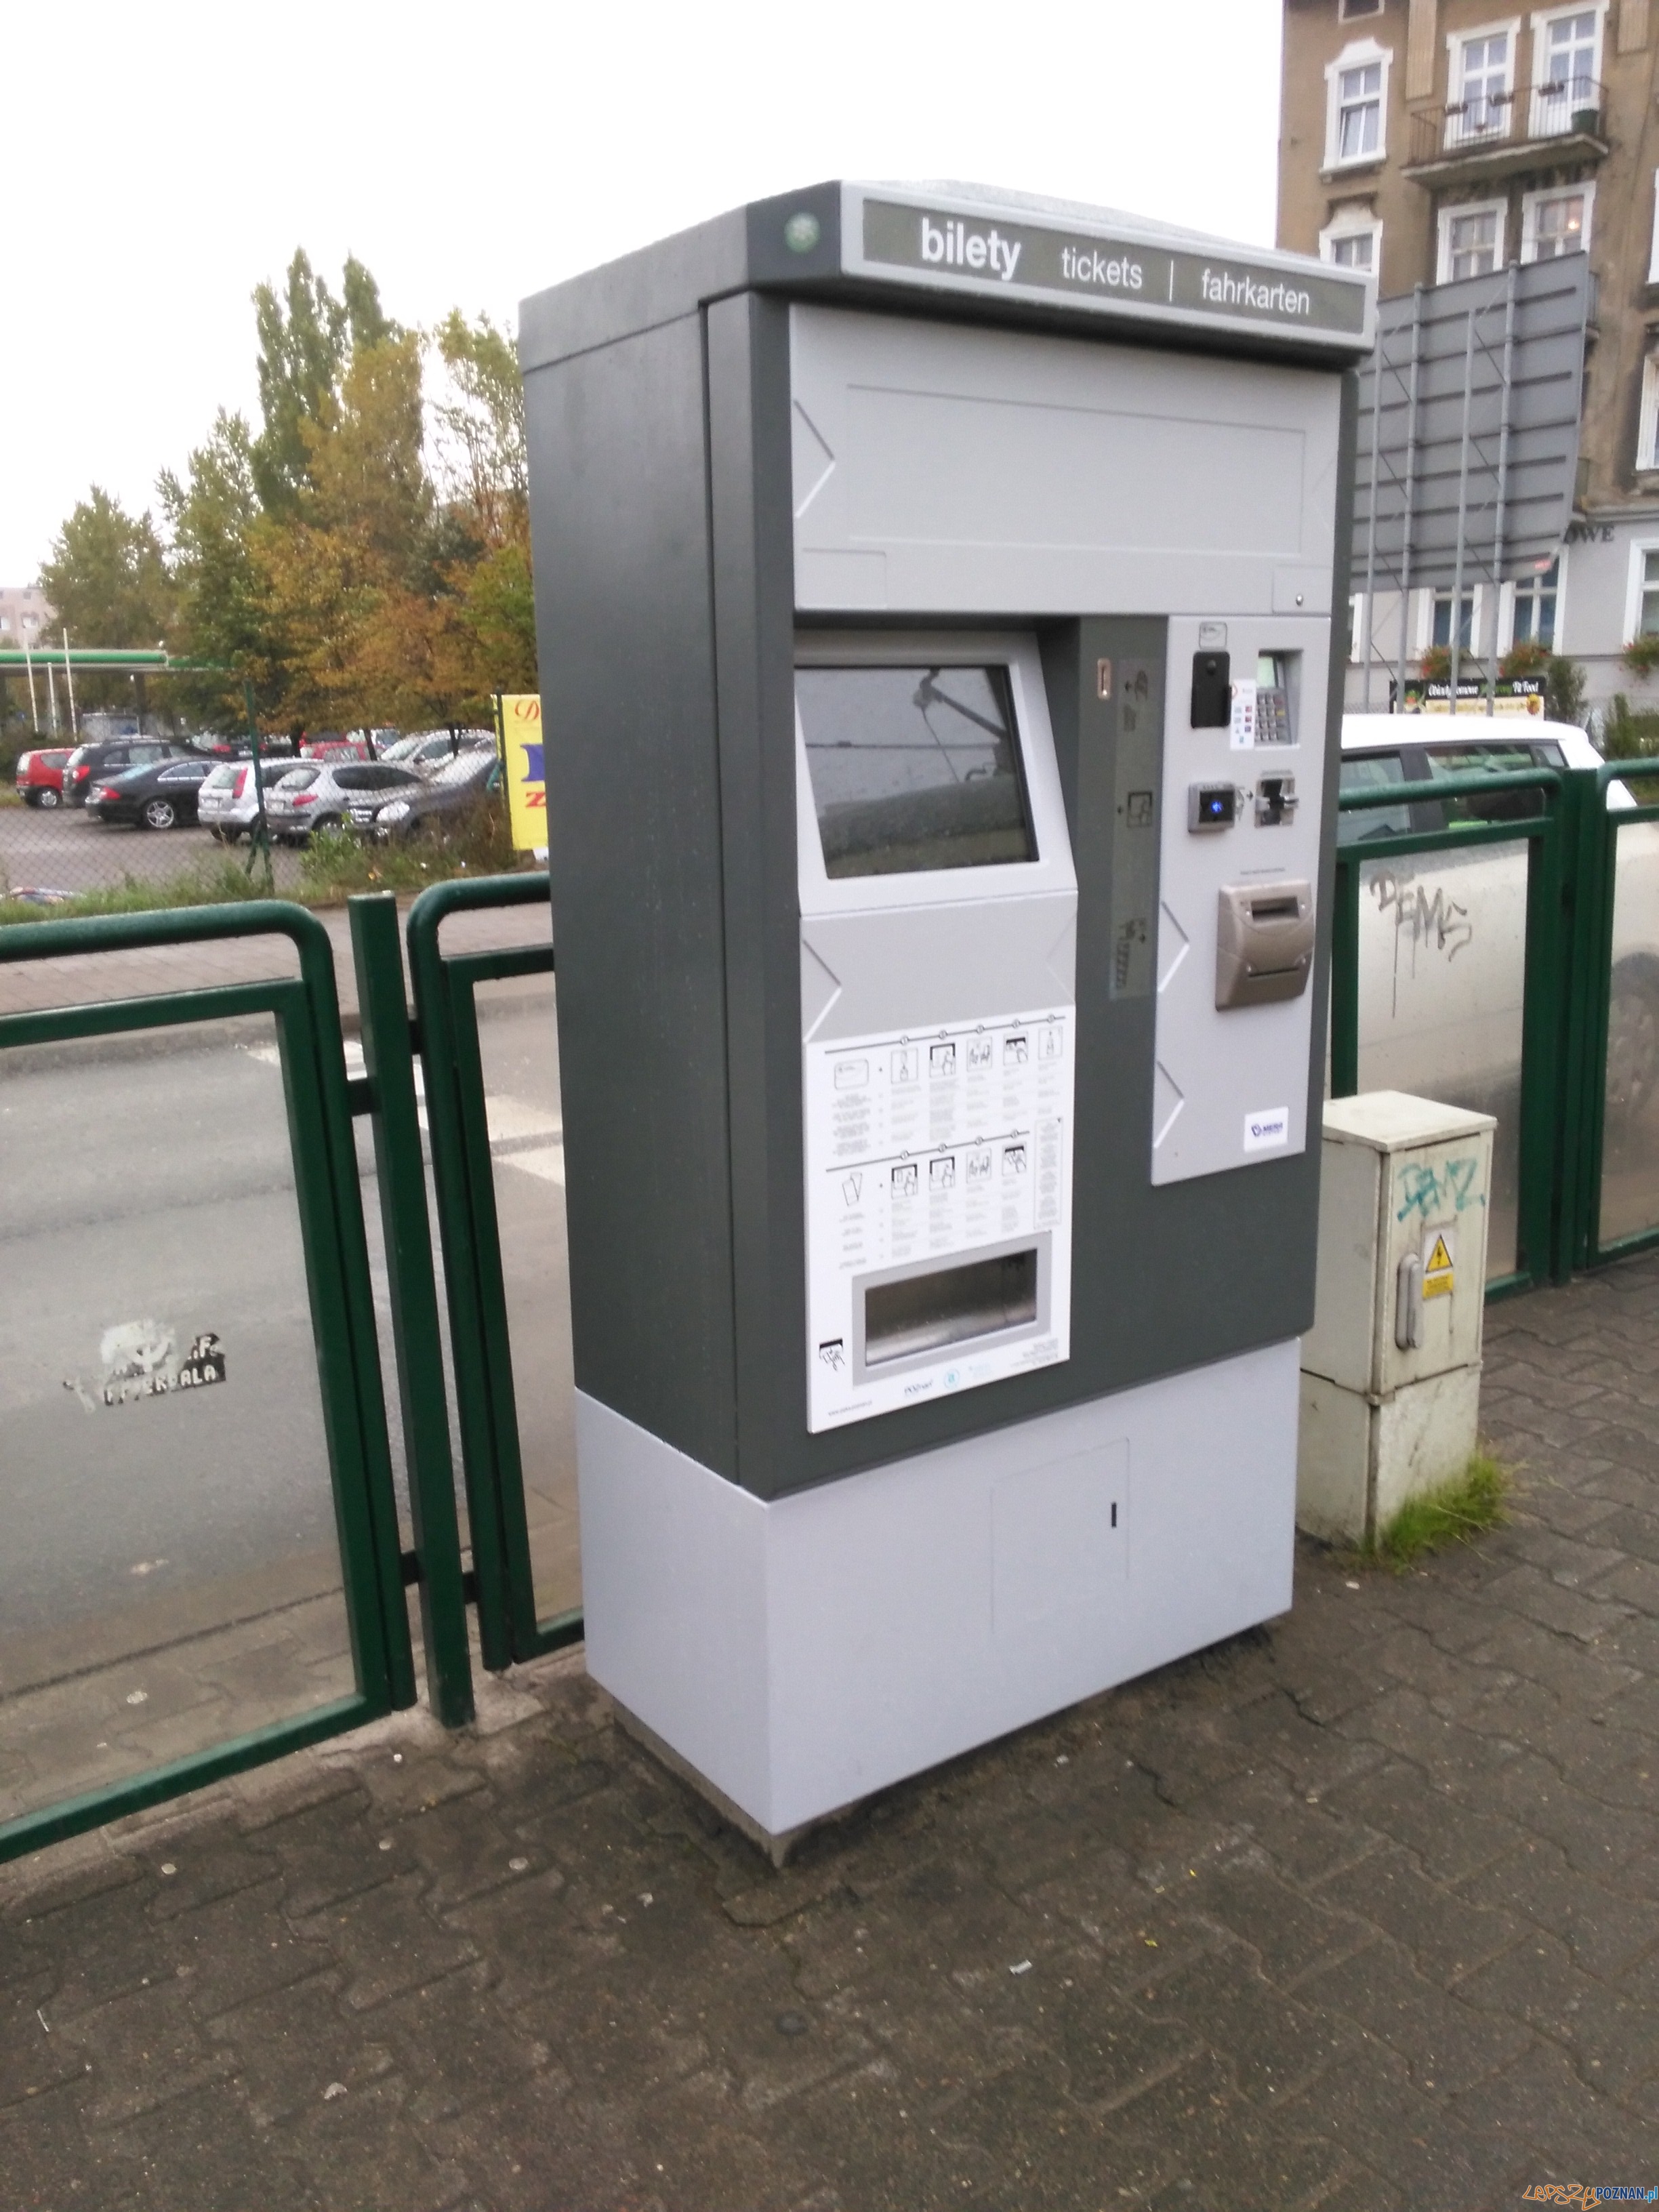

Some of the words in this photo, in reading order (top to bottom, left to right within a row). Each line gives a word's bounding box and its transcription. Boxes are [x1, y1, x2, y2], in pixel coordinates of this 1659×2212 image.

[922, 217, 1021, 281] bilety
[1061, 246, 1143, 289] tickets
[1202, 268, 1310, 315] fahrkarten
